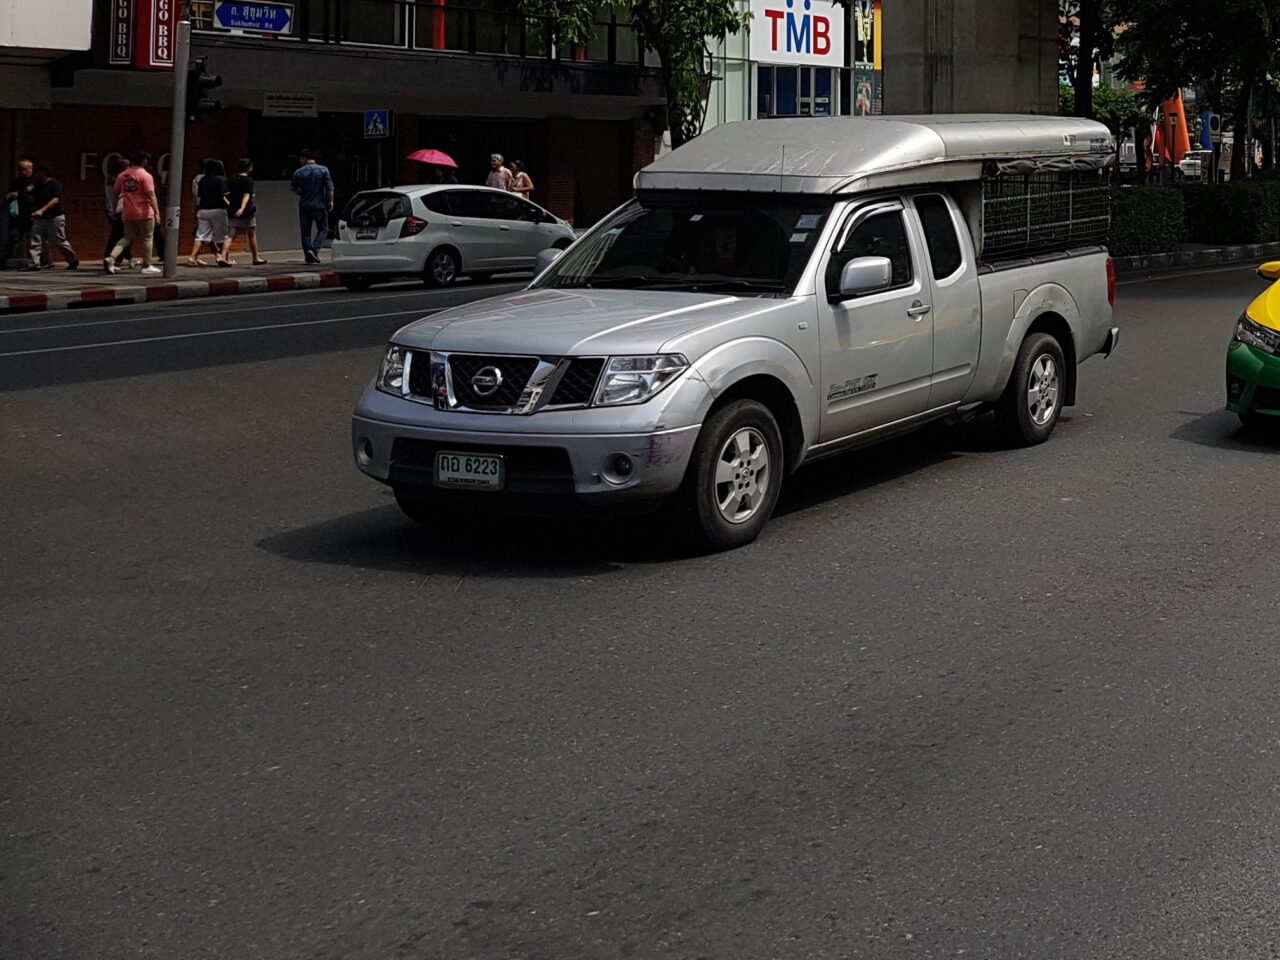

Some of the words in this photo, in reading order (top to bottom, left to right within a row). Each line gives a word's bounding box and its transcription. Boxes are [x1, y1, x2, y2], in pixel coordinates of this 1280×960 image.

[231, 19, 260, 29] Sukhumvit
[243, 6, 277, 21] สุขุมวิท
[117, 23, 127, 57] BBQ
[158, 25, 168, 59] BBQ
[765, 9, 831, 55] TMB
[465, 458, 497, 475] 6223
